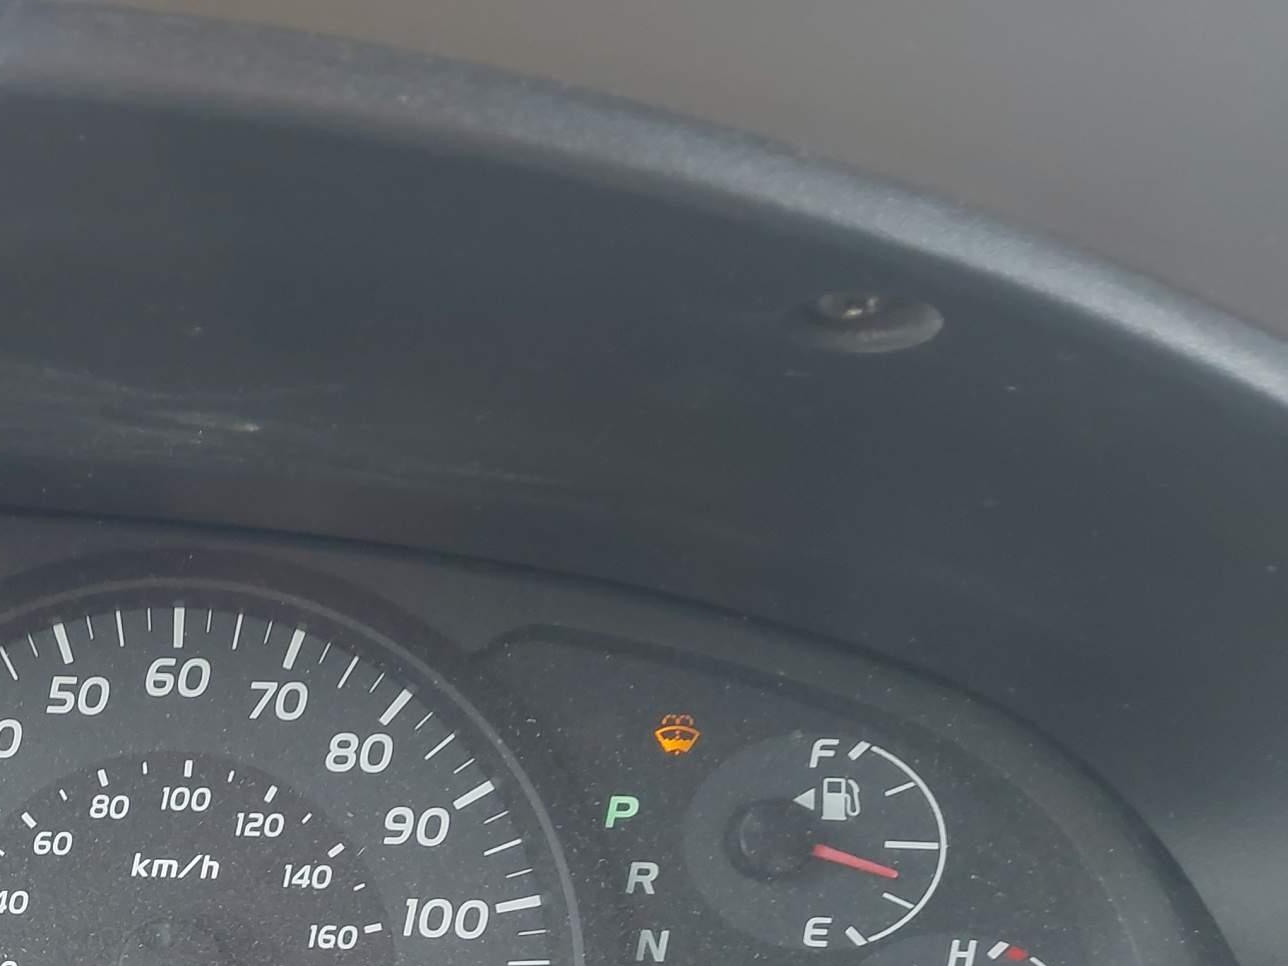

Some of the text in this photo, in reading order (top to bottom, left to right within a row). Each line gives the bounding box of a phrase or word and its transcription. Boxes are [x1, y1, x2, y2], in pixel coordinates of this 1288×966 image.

[144, 657, 211, 698] 60
[47, 676, 109, 716] 50
[249, 681, 308, 720] 70
[326, 734, 392, 773] 80
[809, 739, 839, 768] F
[90, 795, 130, 820] 80
[161, 787, 211, 812] 100
[605, 796, 640, 828] P
[235, 812, 284, 838] 120
[384, 807, 450, 846] 90
[33, 832, 72, 856] 60
[131, 854, 220, 880] km/h
[282, 864, 332, 890] 140
[626, 862, 659, 894] R
[404, 899, 488, 938] 100
[802, 918, 832, 947] E
[308, 925, 358, 950] 160
[636, 930, 670, 963] N
